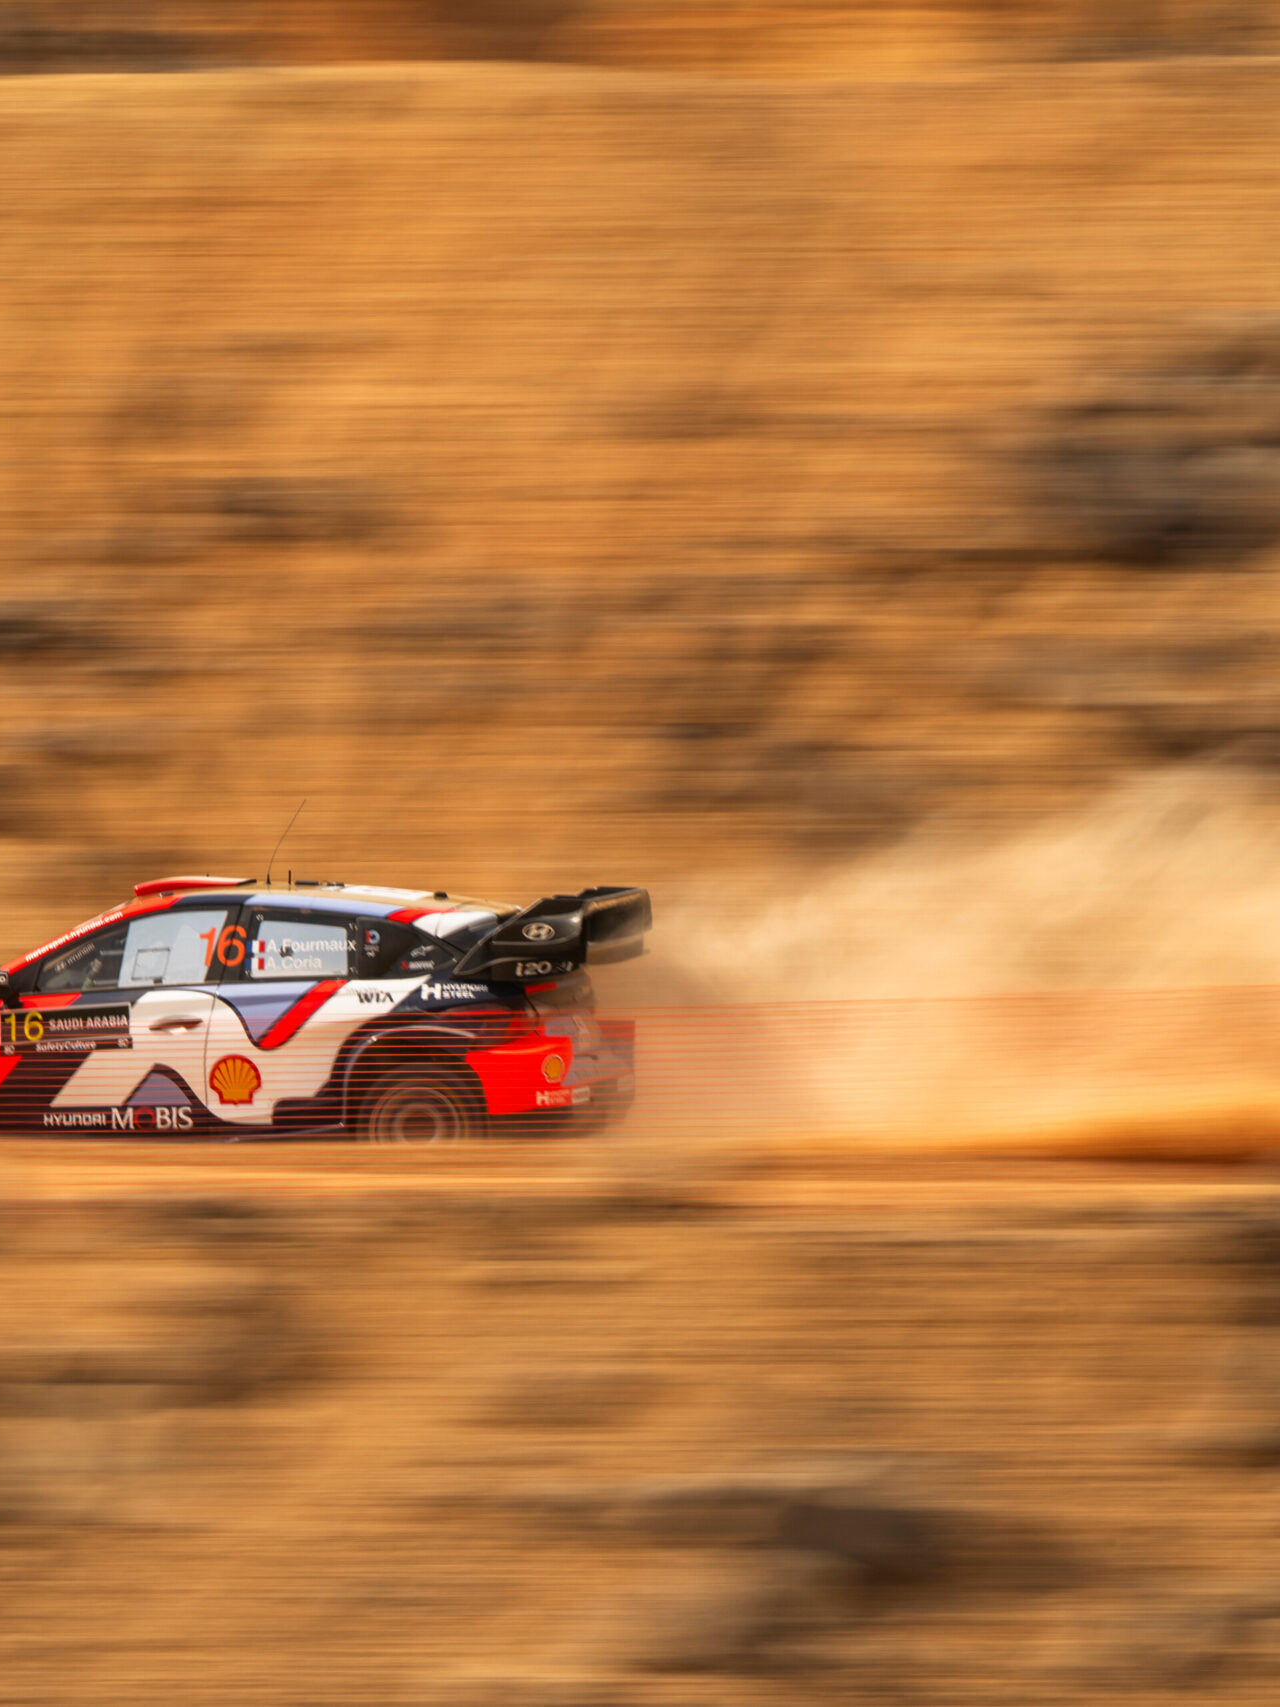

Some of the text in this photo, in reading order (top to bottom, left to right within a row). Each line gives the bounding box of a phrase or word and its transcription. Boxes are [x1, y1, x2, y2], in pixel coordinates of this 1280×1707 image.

[25, 910, 124, 963] motorsport.hyundai.com
[200, 925, 247, 968] 16
[4, 1011, 129, 1042] 16 SAUDI ARABIA
[43, 1106, 194, 1130] HYUNDAI MOBIS
